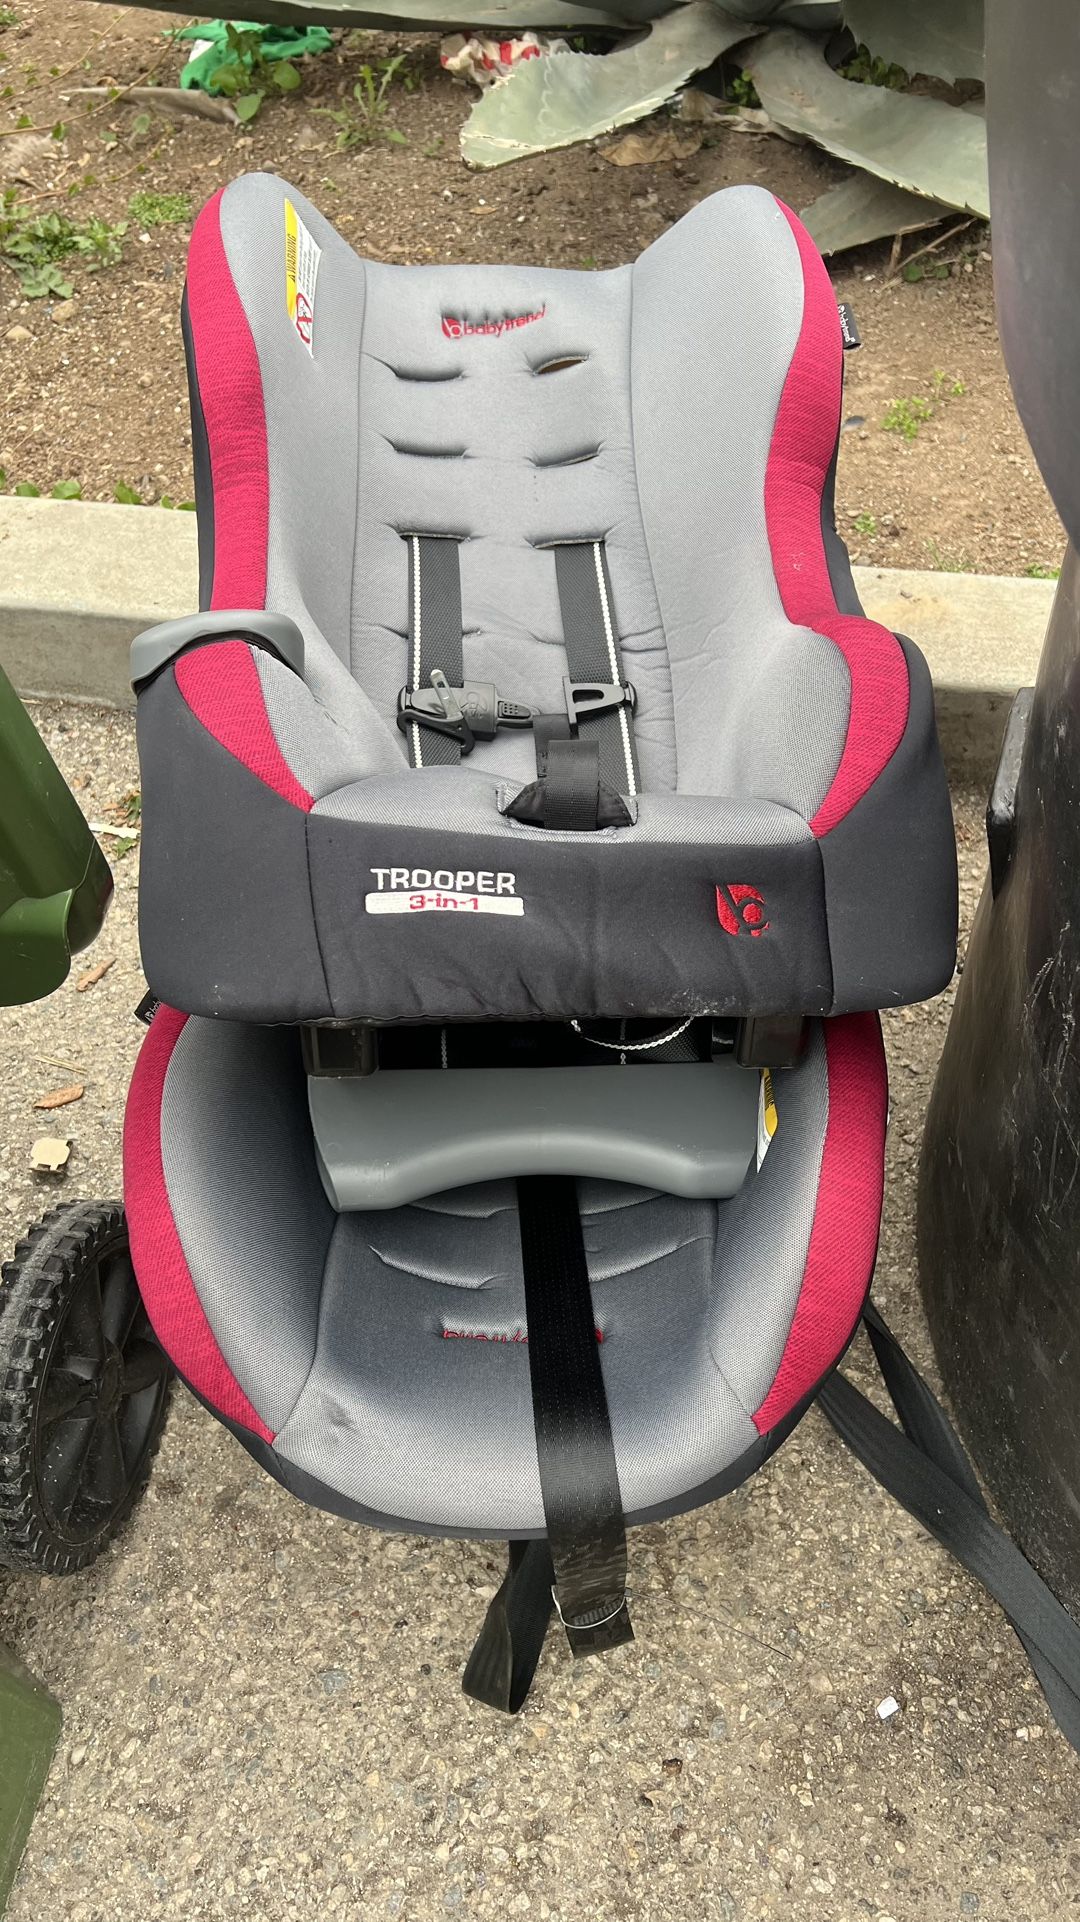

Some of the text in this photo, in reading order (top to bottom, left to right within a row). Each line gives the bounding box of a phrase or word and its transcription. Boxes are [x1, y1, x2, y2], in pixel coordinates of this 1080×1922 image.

[285, 232, 297, 274] WARNING
[370, 867, 517, 895] TROOPER
[409, 893, 479, 911] 3-in-1
